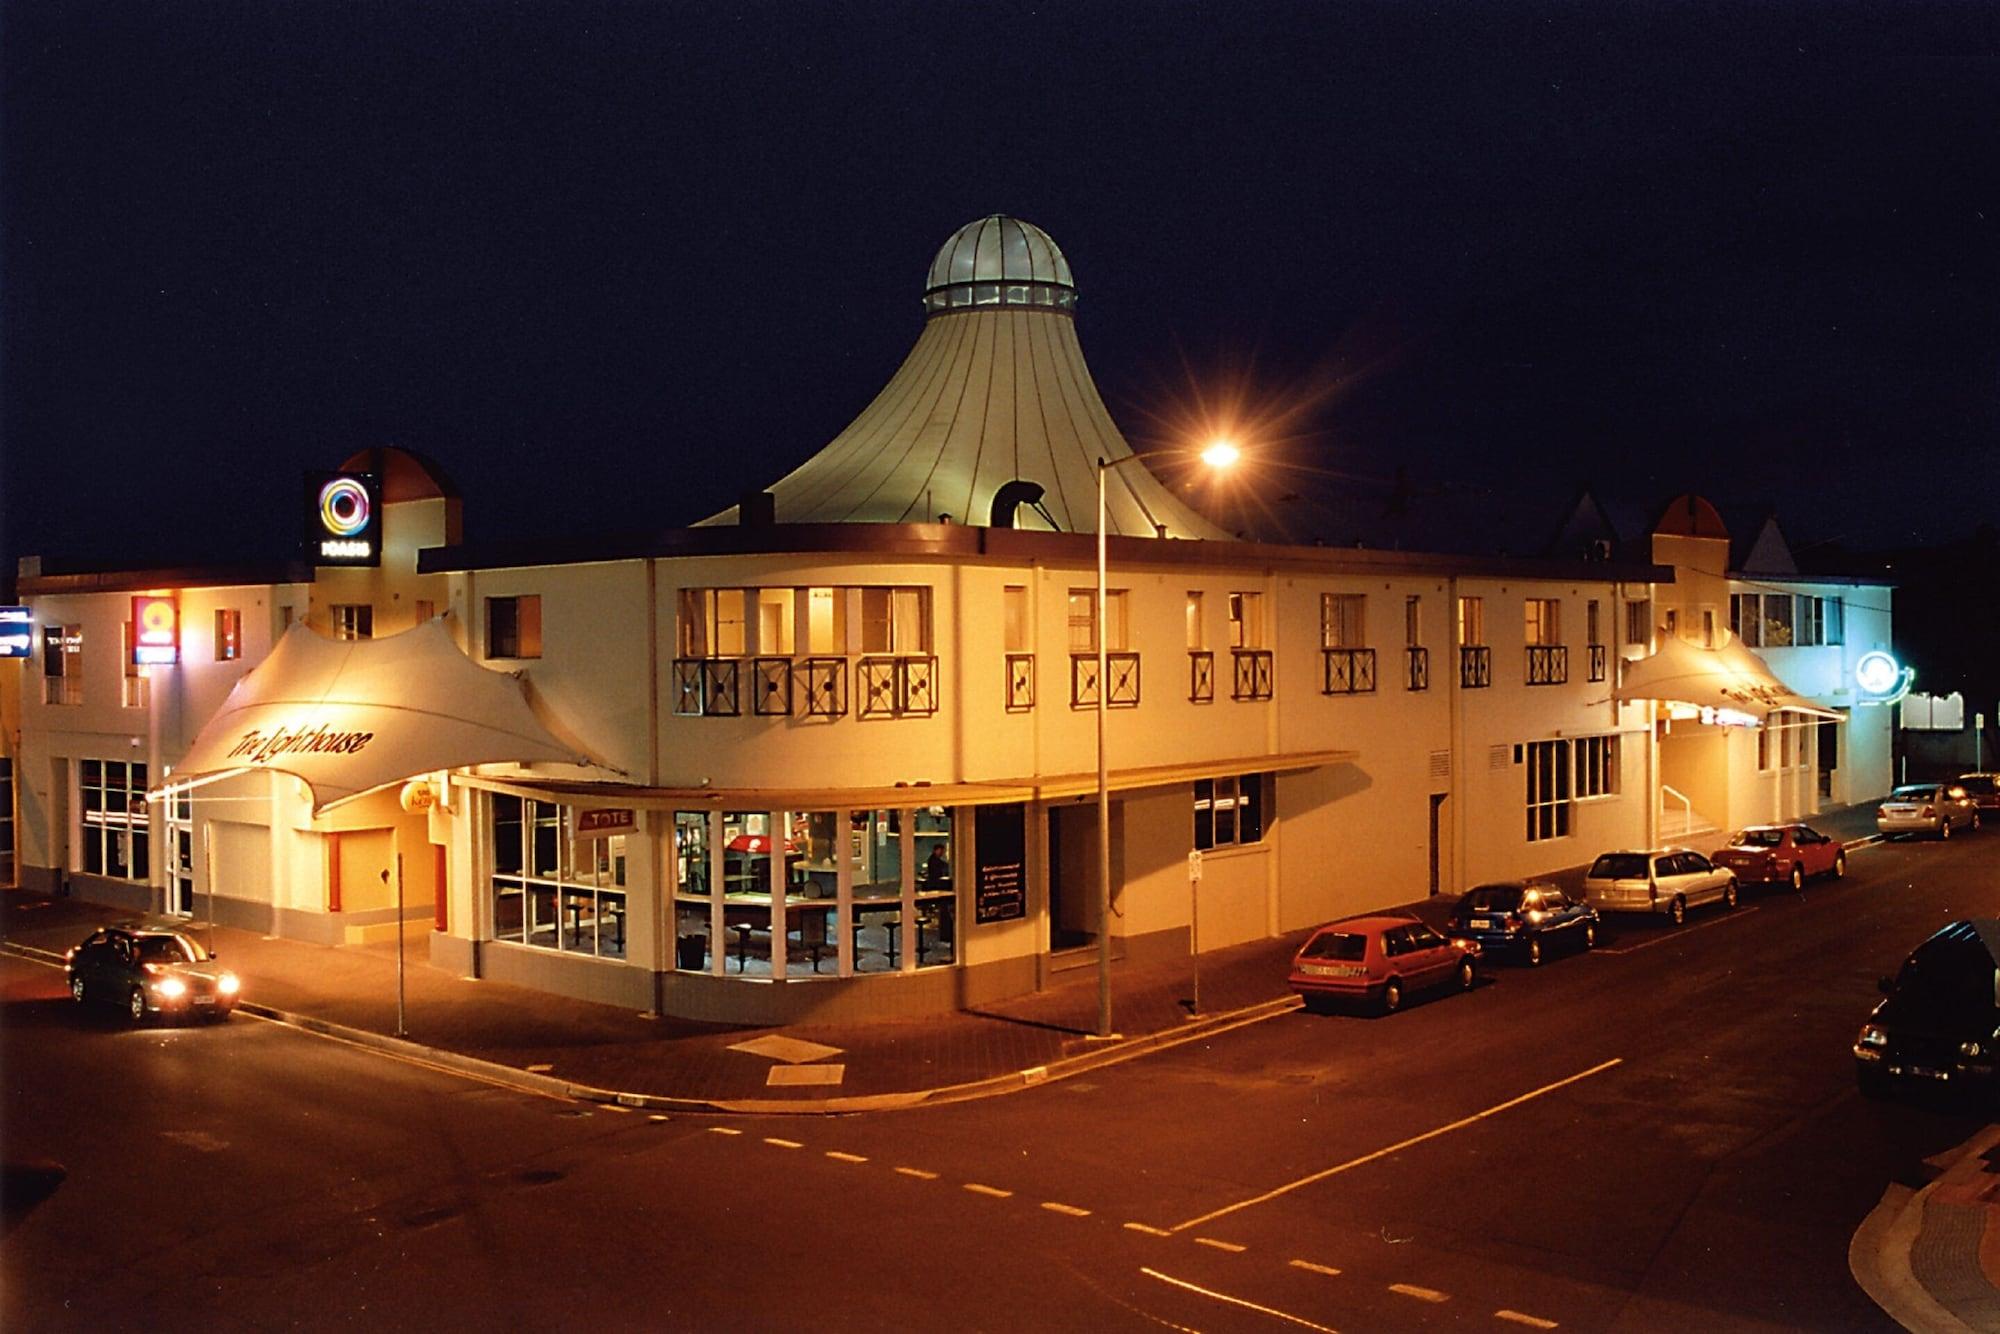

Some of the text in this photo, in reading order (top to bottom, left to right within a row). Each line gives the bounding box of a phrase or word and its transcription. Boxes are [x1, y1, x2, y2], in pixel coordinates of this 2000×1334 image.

[227, 723, 374, 763] The Lighthouse
[591, 811, 629, 825] TOTE
